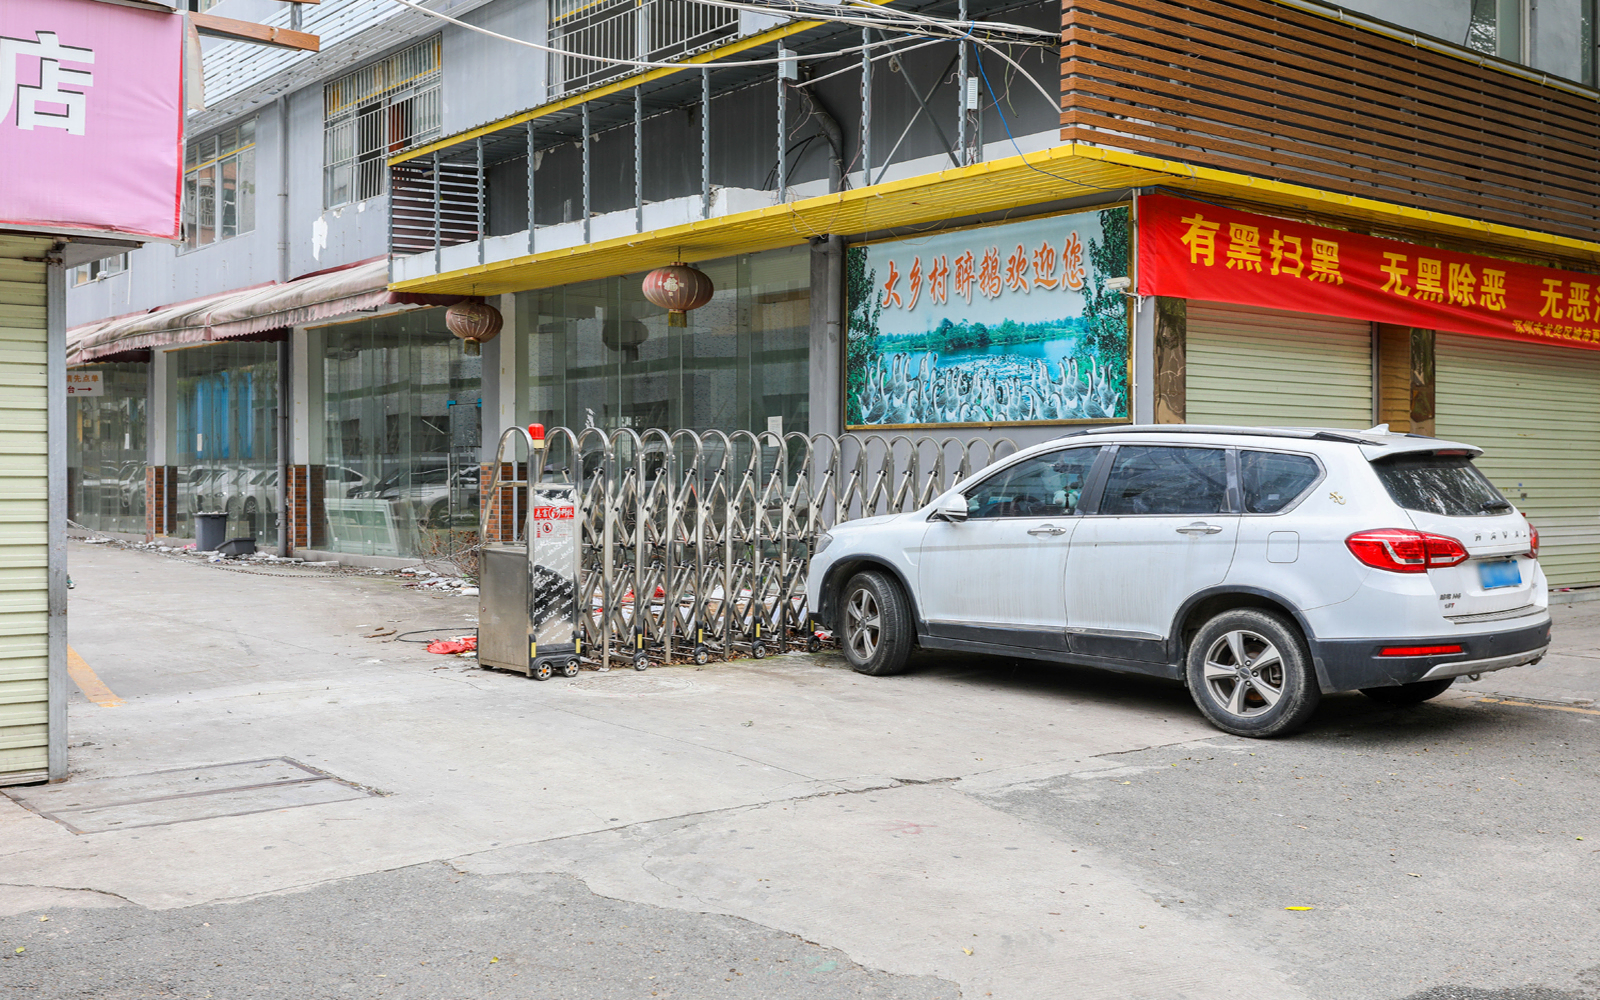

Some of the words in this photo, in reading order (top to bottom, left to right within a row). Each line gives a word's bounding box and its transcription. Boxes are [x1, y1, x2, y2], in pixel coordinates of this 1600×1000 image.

[0, 30, 95, 136] 店
[882, 230, 1087, 310] 大乡村醉鹅欢迎您
[1180, 213, 1344, 286] 有黑扫黑
[1380, 251, 1507, 311] 无黑除恶
[1539, 277, 1600, 324] 无恶
